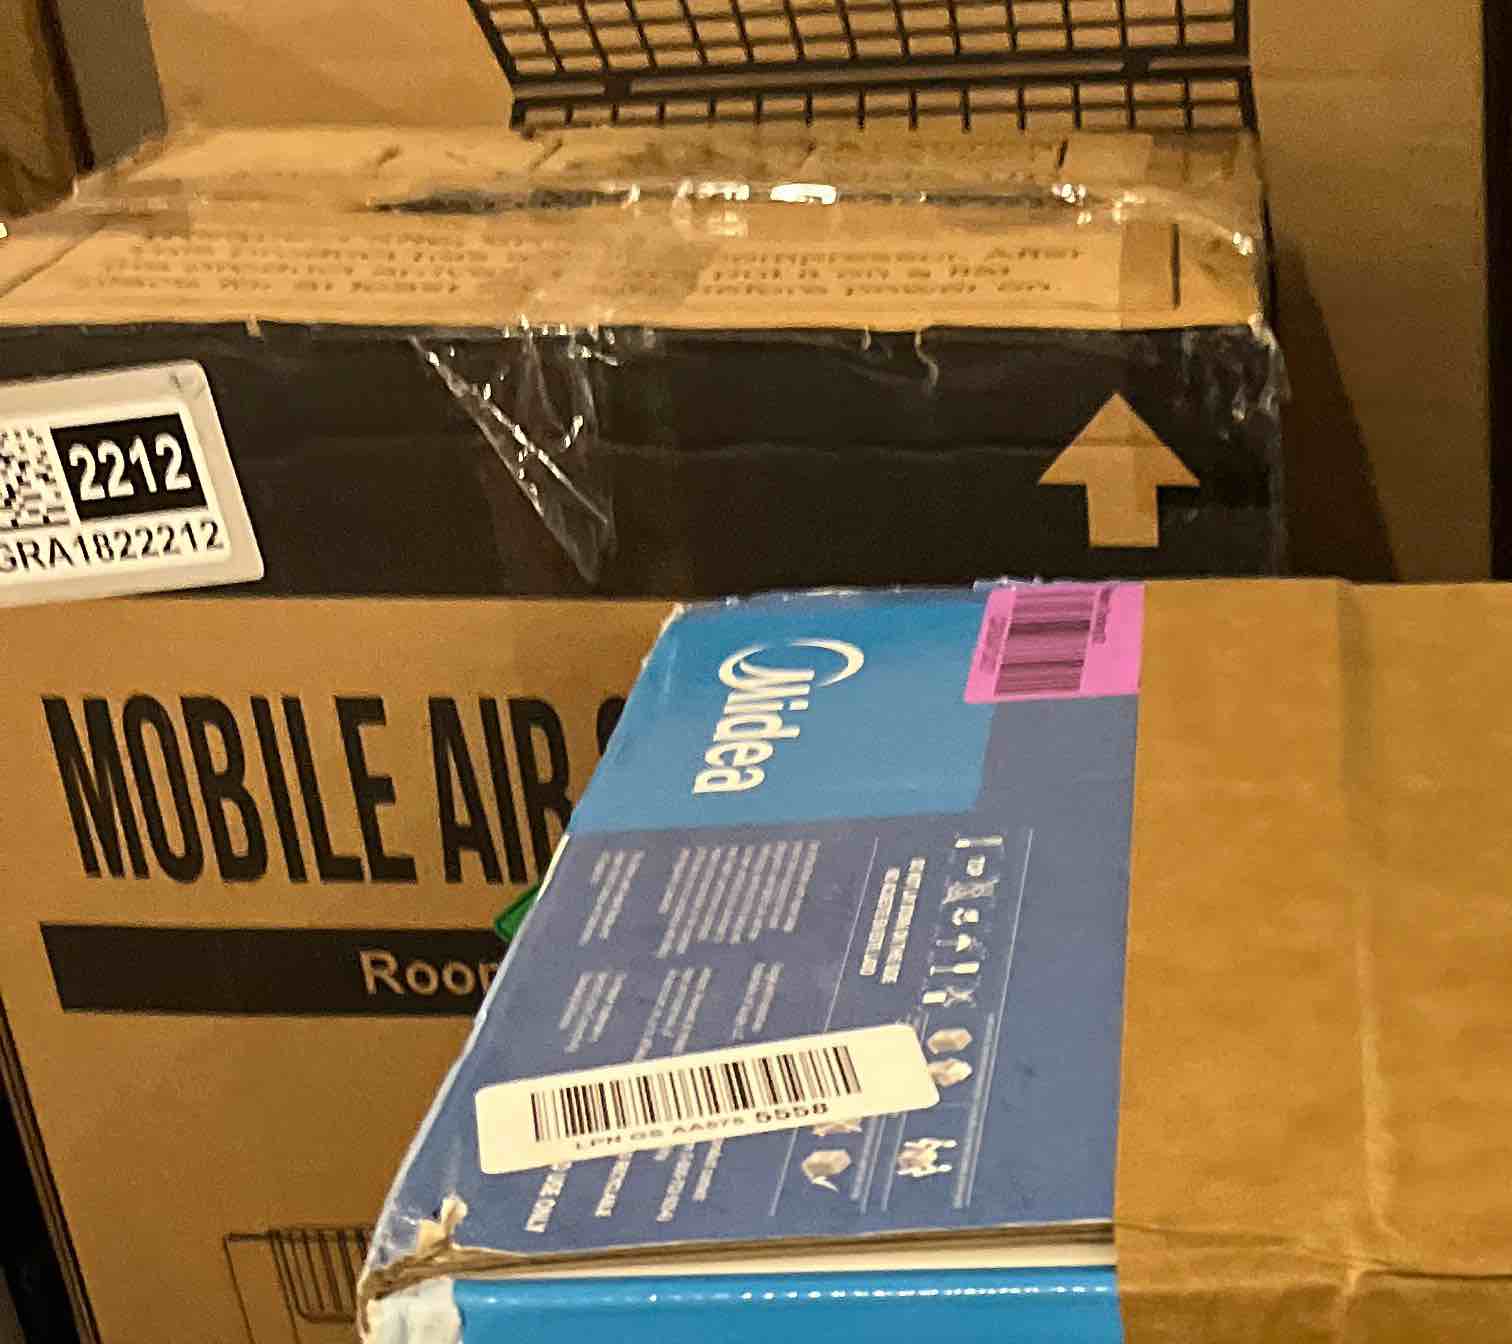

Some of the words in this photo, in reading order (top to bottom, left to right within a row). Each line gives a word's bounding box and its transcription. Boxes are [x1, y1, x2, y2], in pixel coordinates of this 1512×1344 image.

[68, 432, 193, 501] 2212
[40, 694, 418, 886] MOBILE
[427, 694, 573, 886] AIR
[692, 637, 866, 796] Midea
